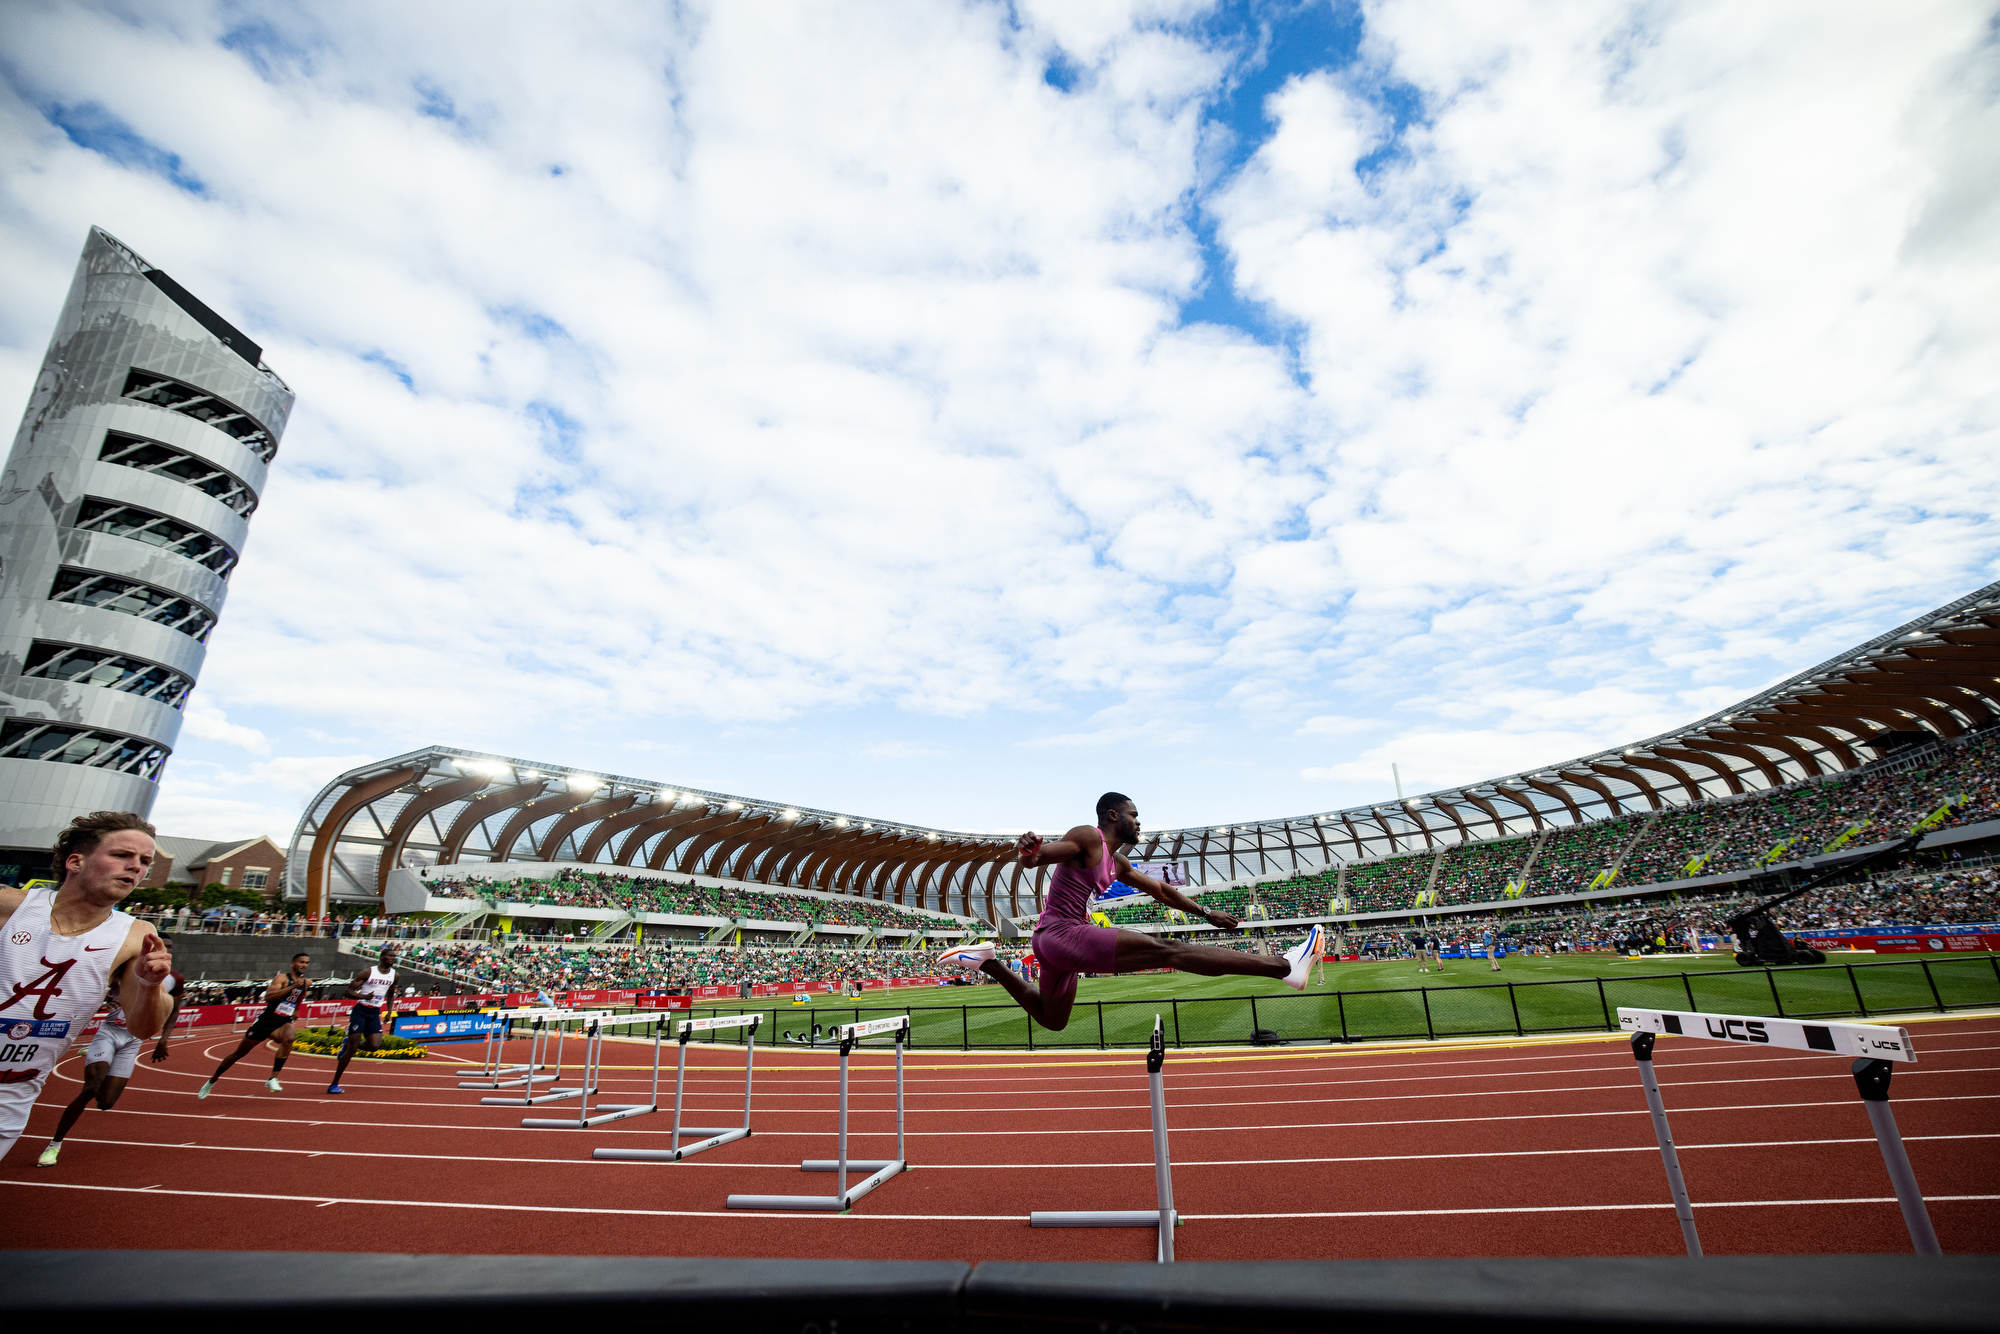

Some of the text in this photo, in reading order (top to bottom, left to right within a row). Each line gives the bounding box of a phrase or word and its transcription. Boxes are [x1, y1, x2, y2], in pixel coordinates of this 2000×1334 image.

[1705, 1018, 1769, 1043] UCS
[1871, 1040, 1900, 1051] UCS
[0, 1044, 39, 1062] DER
[707, 1139, 720, 1147] UCS
